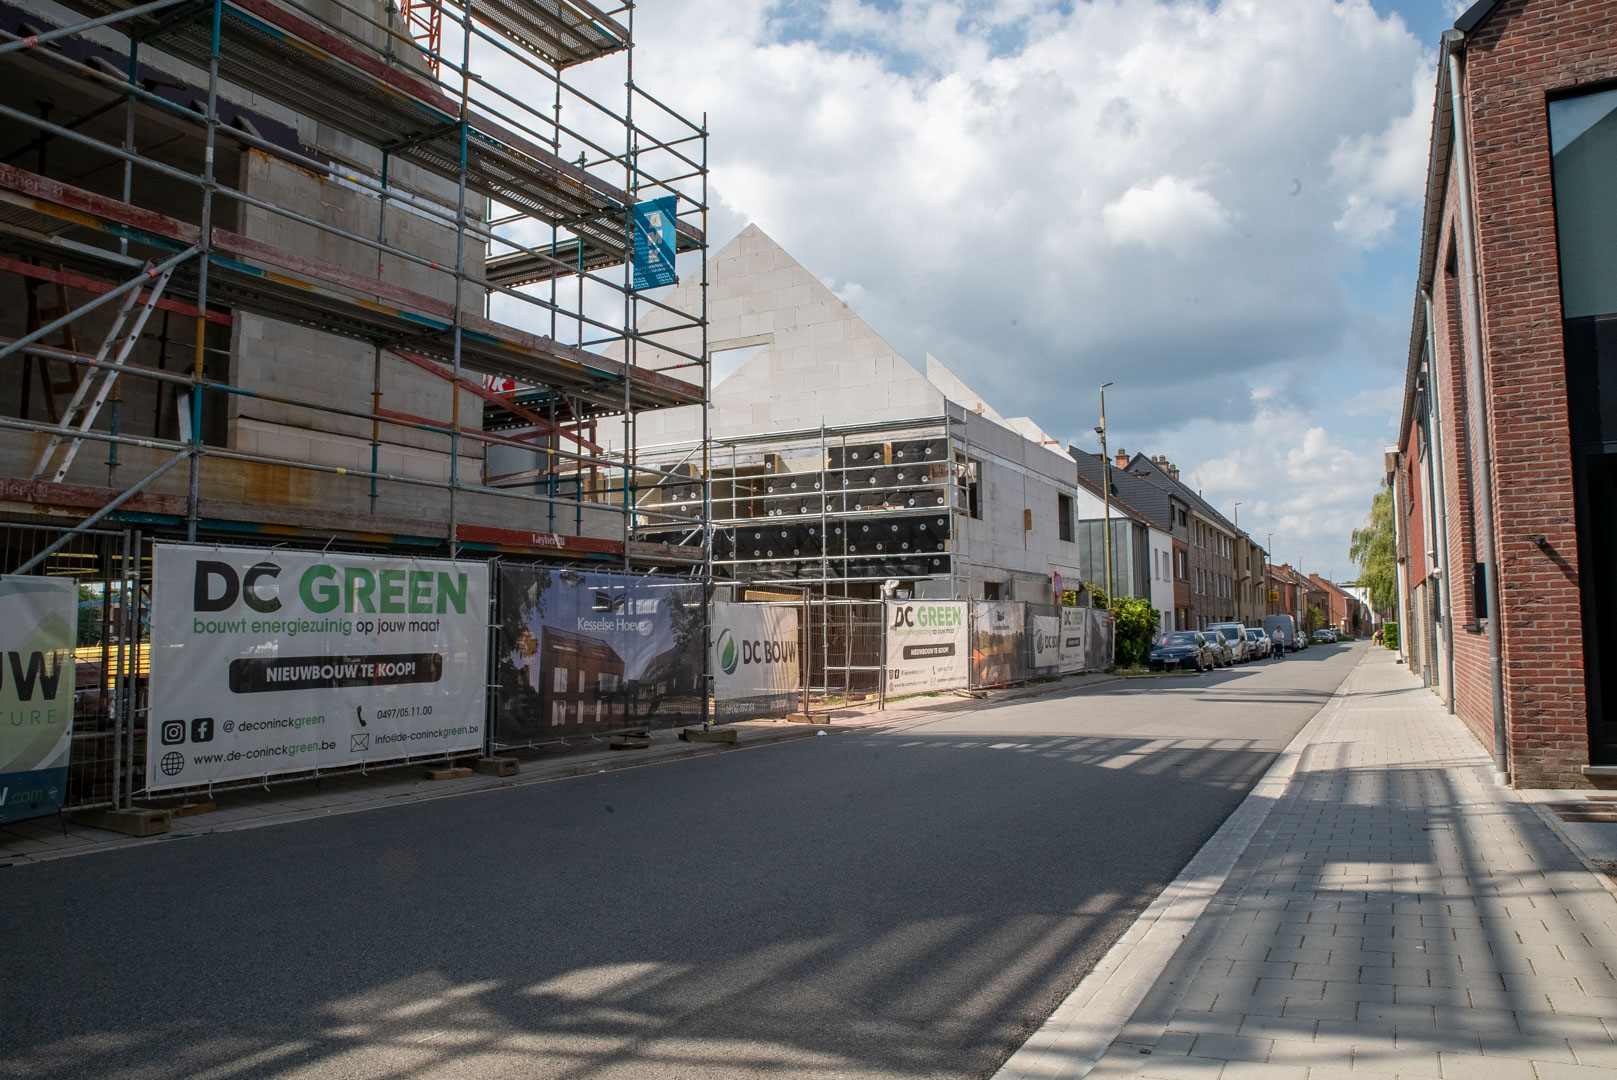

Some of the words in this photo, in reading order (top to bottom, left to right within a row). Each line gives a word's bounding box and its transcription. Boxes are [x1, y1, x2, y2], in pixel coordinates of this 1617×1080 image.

[194, 560, 282, 613] DC
[298, 564, 468, 614] GREEN
[577, 617, 614, 631] Kesselse
[616, 618, 645, 632] Hoeve
[895, 606, 914, 628] DC
[917, 606, 962, 627] GREEN
[193, 618, 246, 634] bouwt
[251, 618, 353, 637] energiezuinig
[356, 621, 374, 635] op
[377, 618, 405, 635] jouw
[408, 618, 440, 633] maat
[742, 639, 762, 665] DC
[764, 640, 796, 664] BOUW
[0, 651, 64, 701] W
[266, 665, 357, 682] NIEUWBOUW
[361, 664, 374, 678] TE
[378, 662, 416, 677] KOOP!
[0, 709, 57, 726] URE
[377, 706, 433, 719] 0497/05.11.00
[238, 714, 325, 732] deconinckgreen
[375, 725, 479, 744] info@de-coninckgreen.be
[193, 740, 336, 765] www.de-coninckgreen.be
